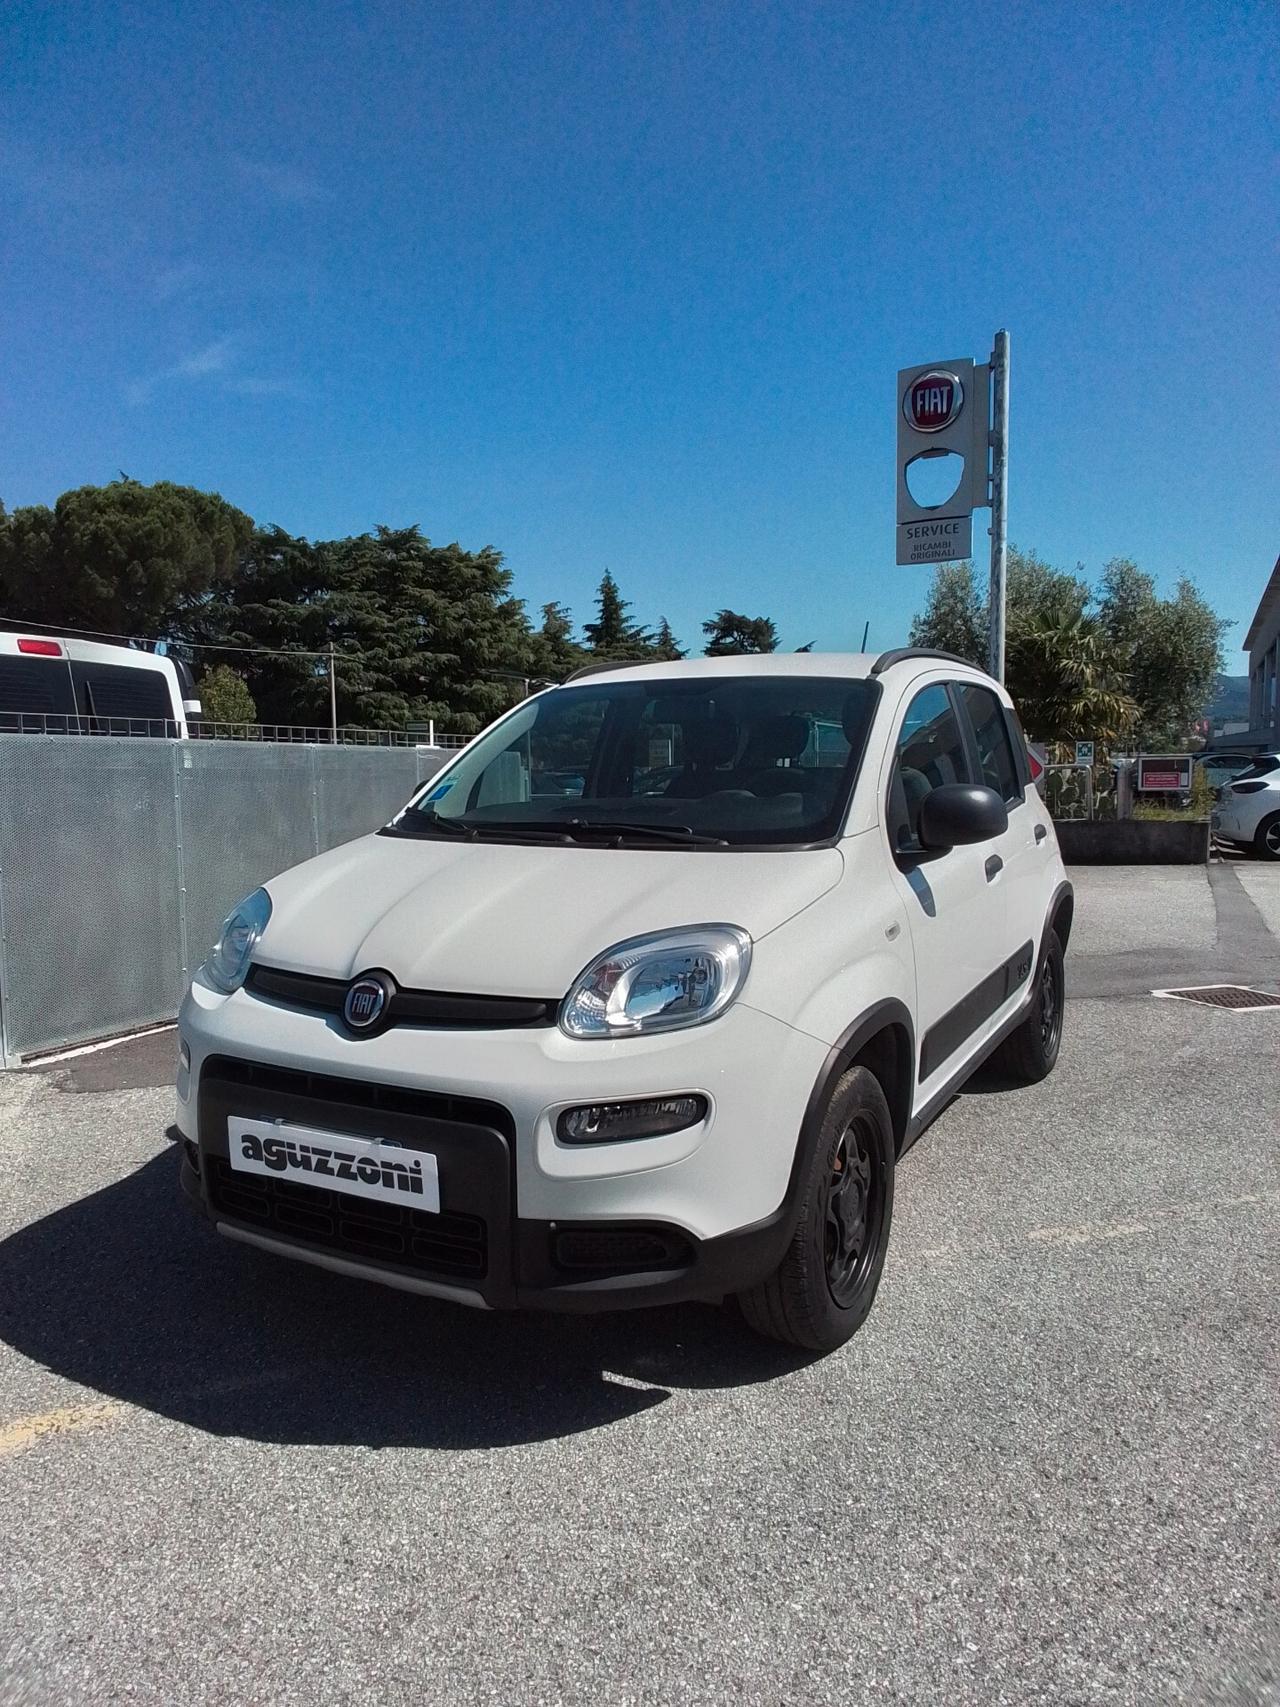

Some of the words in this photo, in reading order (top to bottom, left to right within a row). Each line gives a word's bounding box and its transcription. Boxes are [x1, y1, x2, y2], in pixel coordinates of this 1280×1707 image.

[916, 386, 951, 417] FIAT
[906, 523, 960, 540] SERVICE
[911, 549, 955, 560] ORIGINALI
[913, 541, 951, 552] RICAMBI
[352, 992, 377, 1015] FIAT
[240, 1134, 424, 1195] aguzzoni
